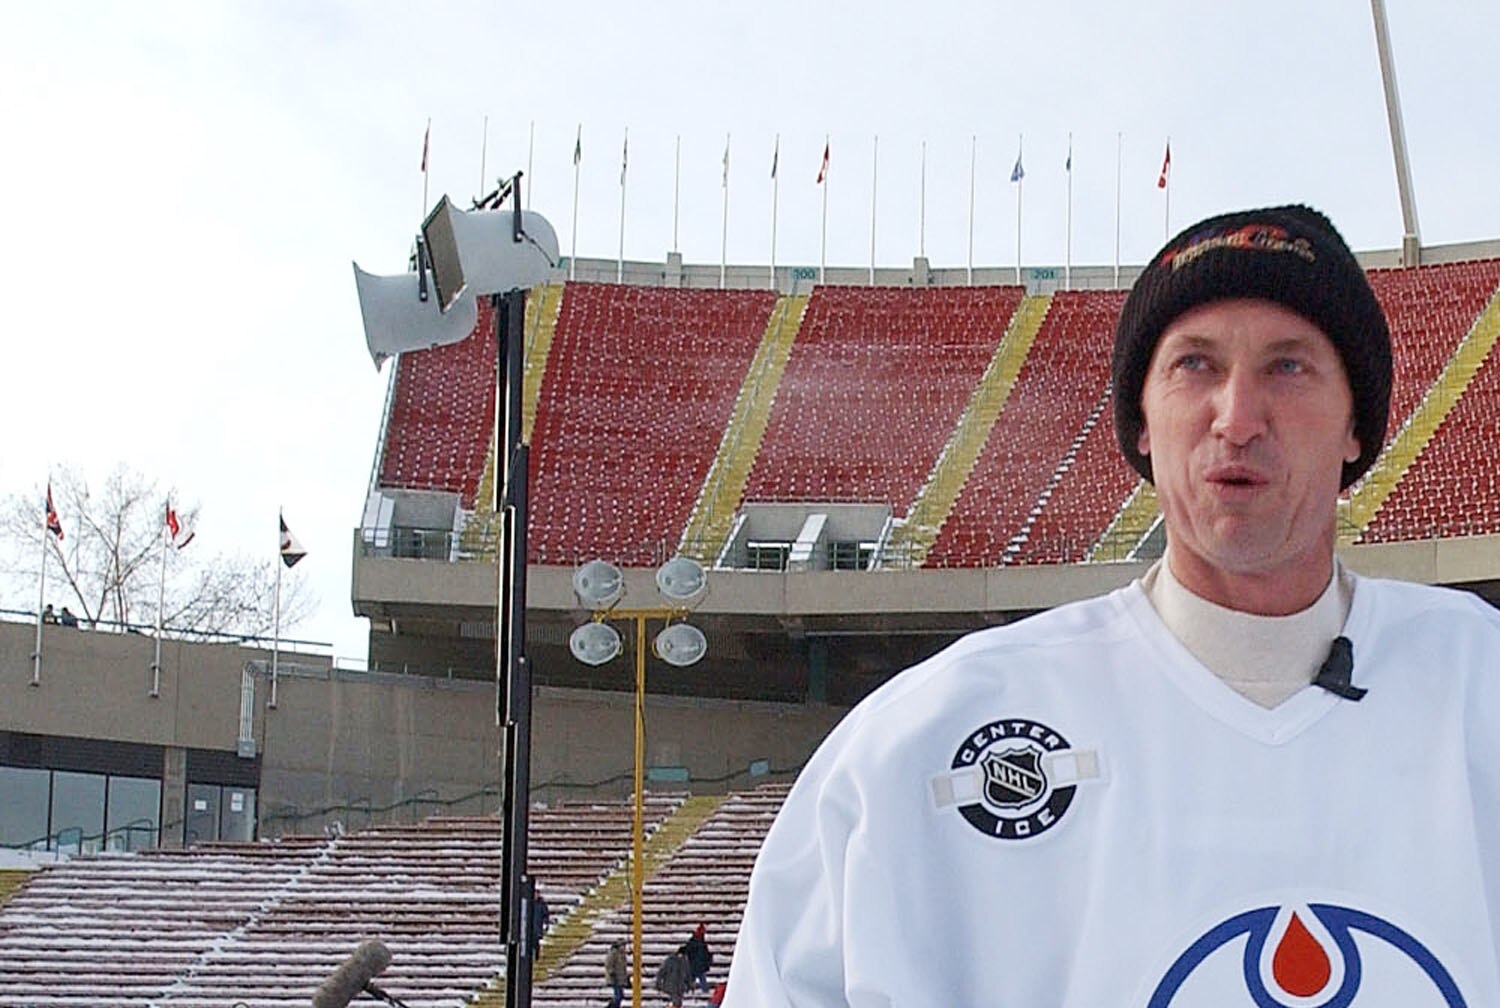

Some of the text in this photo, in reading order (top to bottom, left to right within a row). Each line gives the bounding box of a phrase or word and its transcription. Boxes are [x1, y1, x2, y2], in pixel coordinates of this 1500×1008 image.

[961, 722, 1060, 764] CENTER
[992, 762, 1037, 794] NHL
[995, 807, 1055, 836] ICE
